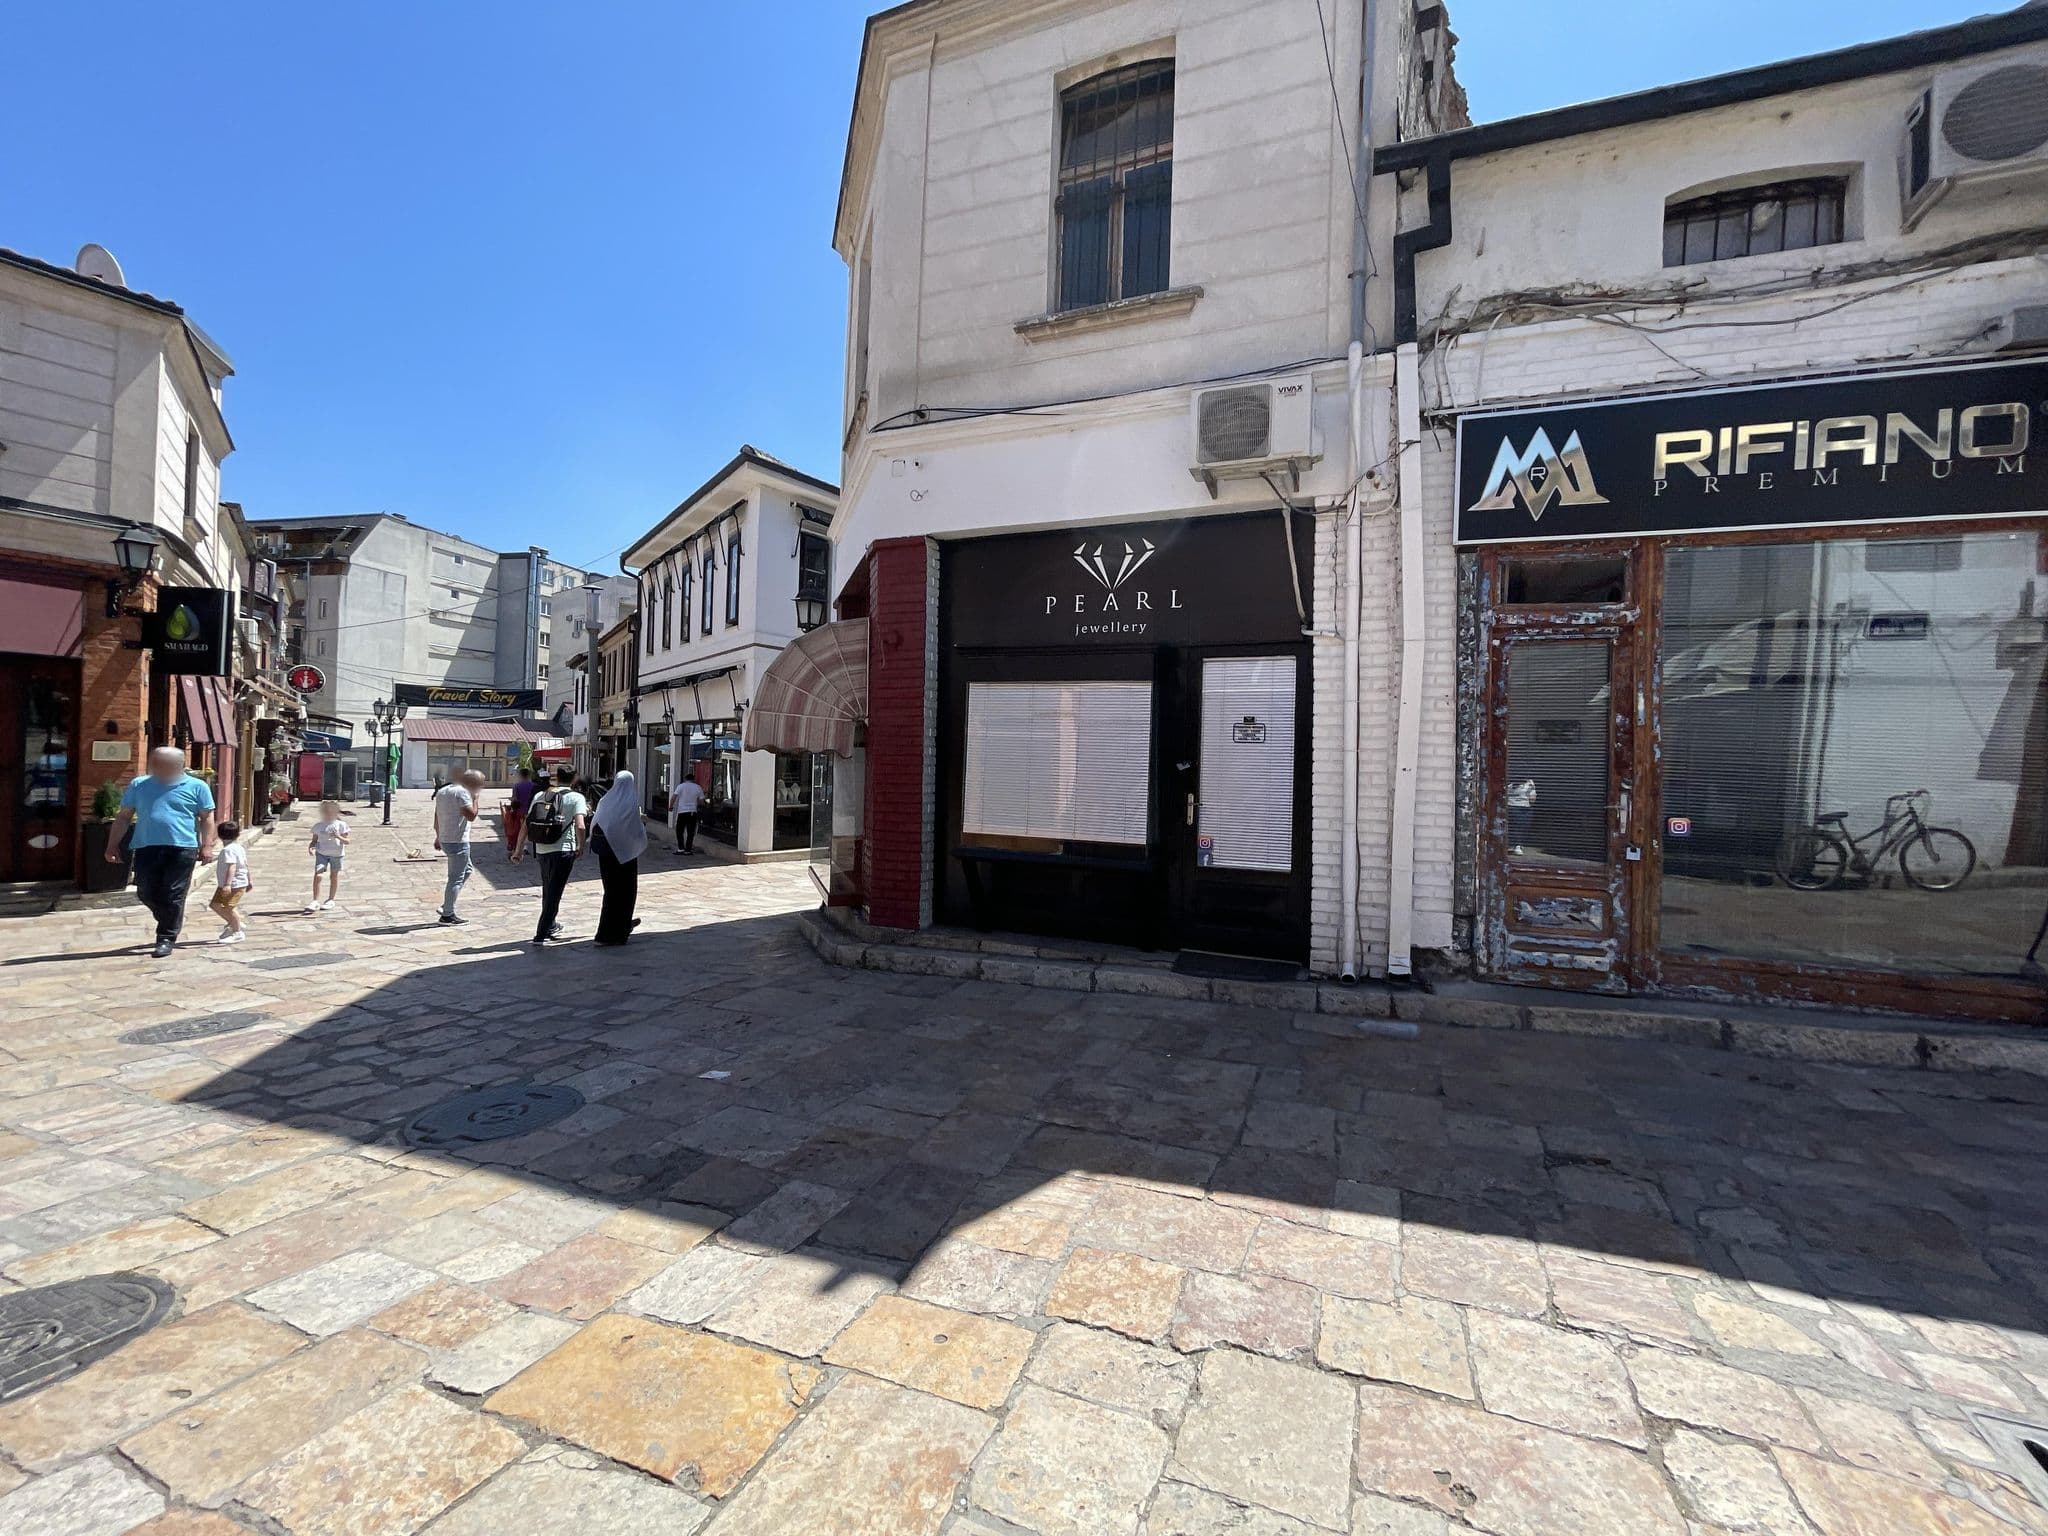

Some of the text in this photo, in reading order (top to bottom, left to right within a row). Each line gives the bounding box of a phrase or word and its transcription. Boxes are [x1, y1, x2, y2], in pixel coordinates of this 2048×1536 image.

[1278, 384, 1303, 393] VIVAX
[1653, 402, 2030, 480] RIFIANO
[1653, 455, 2026, 497] PREMIUM
[1045, 589, 1183, 614] PEARL
[1074, 621, 1147, 636] jewellery
[426, 687, 472, 702] Travel
[479, 689, 516, 708] Story
